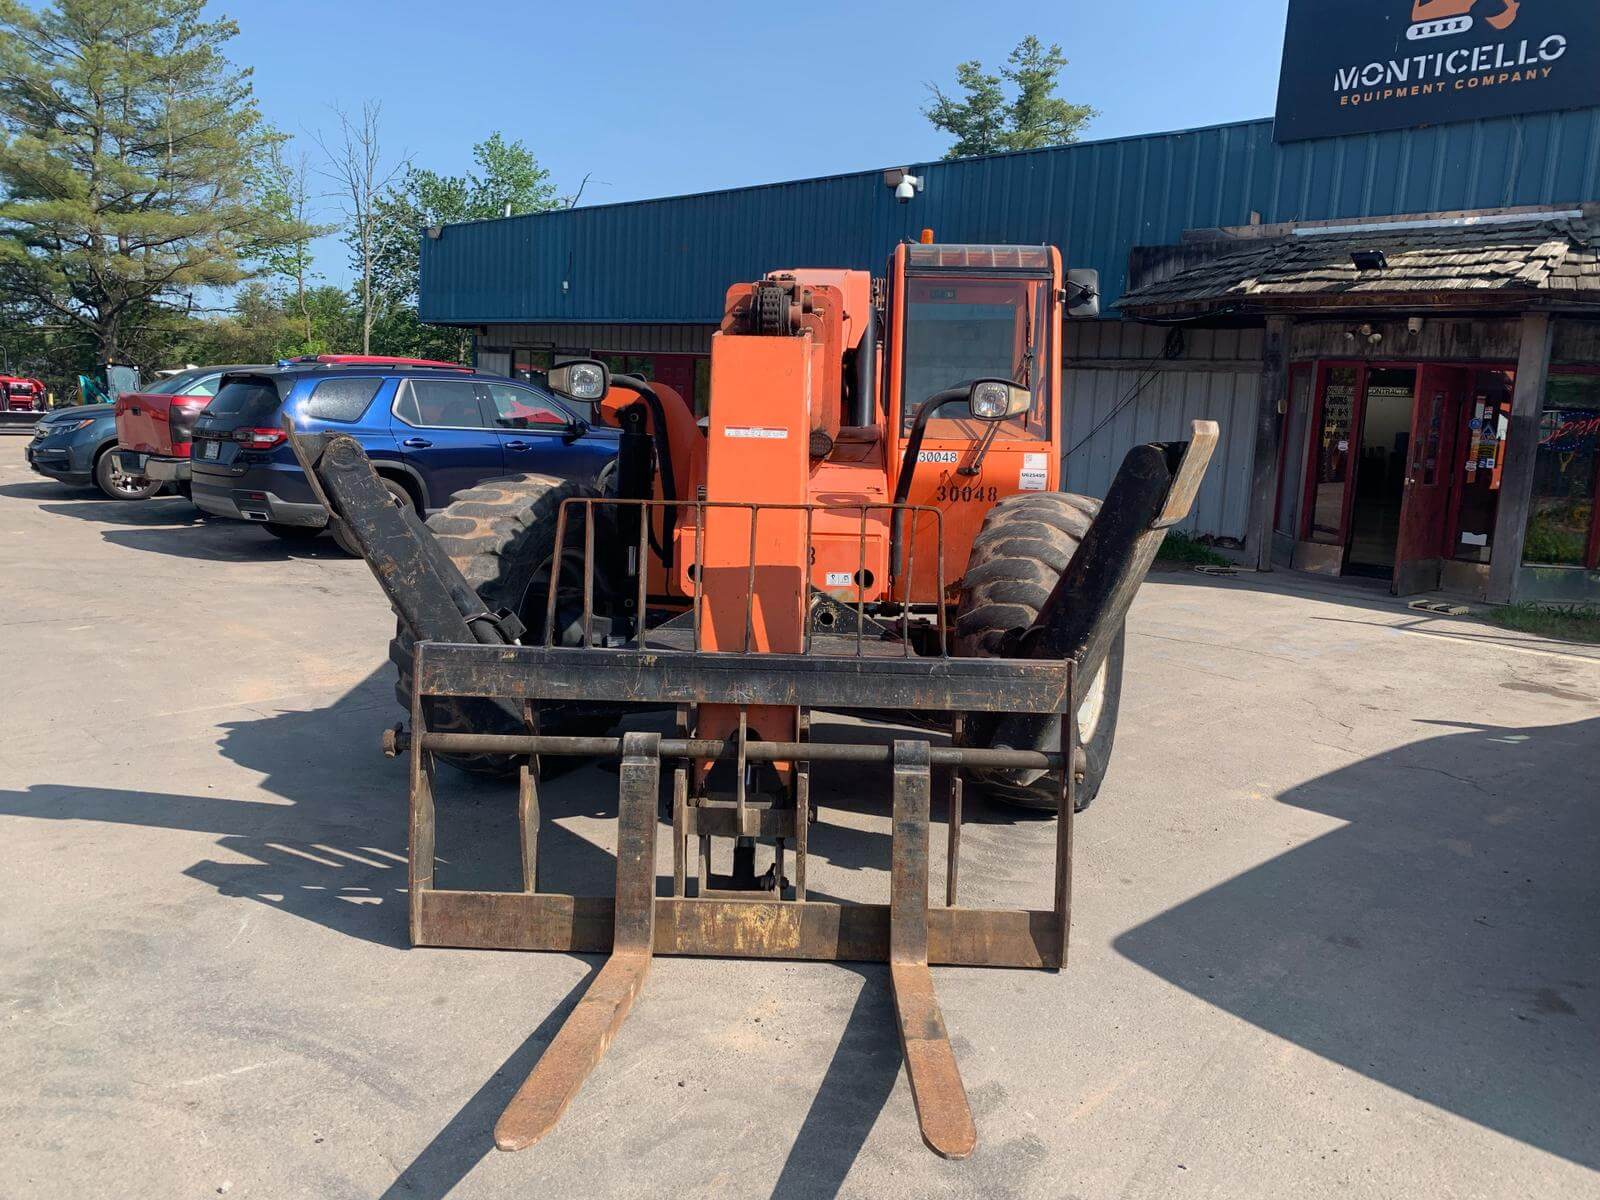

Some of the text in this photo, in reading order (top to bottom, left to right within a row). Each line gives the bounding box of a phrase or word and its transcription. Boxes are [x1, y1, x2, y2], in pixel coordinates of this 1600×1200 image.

[1333, 34, 1567, 91] MONTICELLO
[1340, 66, 1553, 106] EQUIPMENT COMPANY
[919, 451, 957, 463] 30048
[936, 486, 997, 502] 30048
